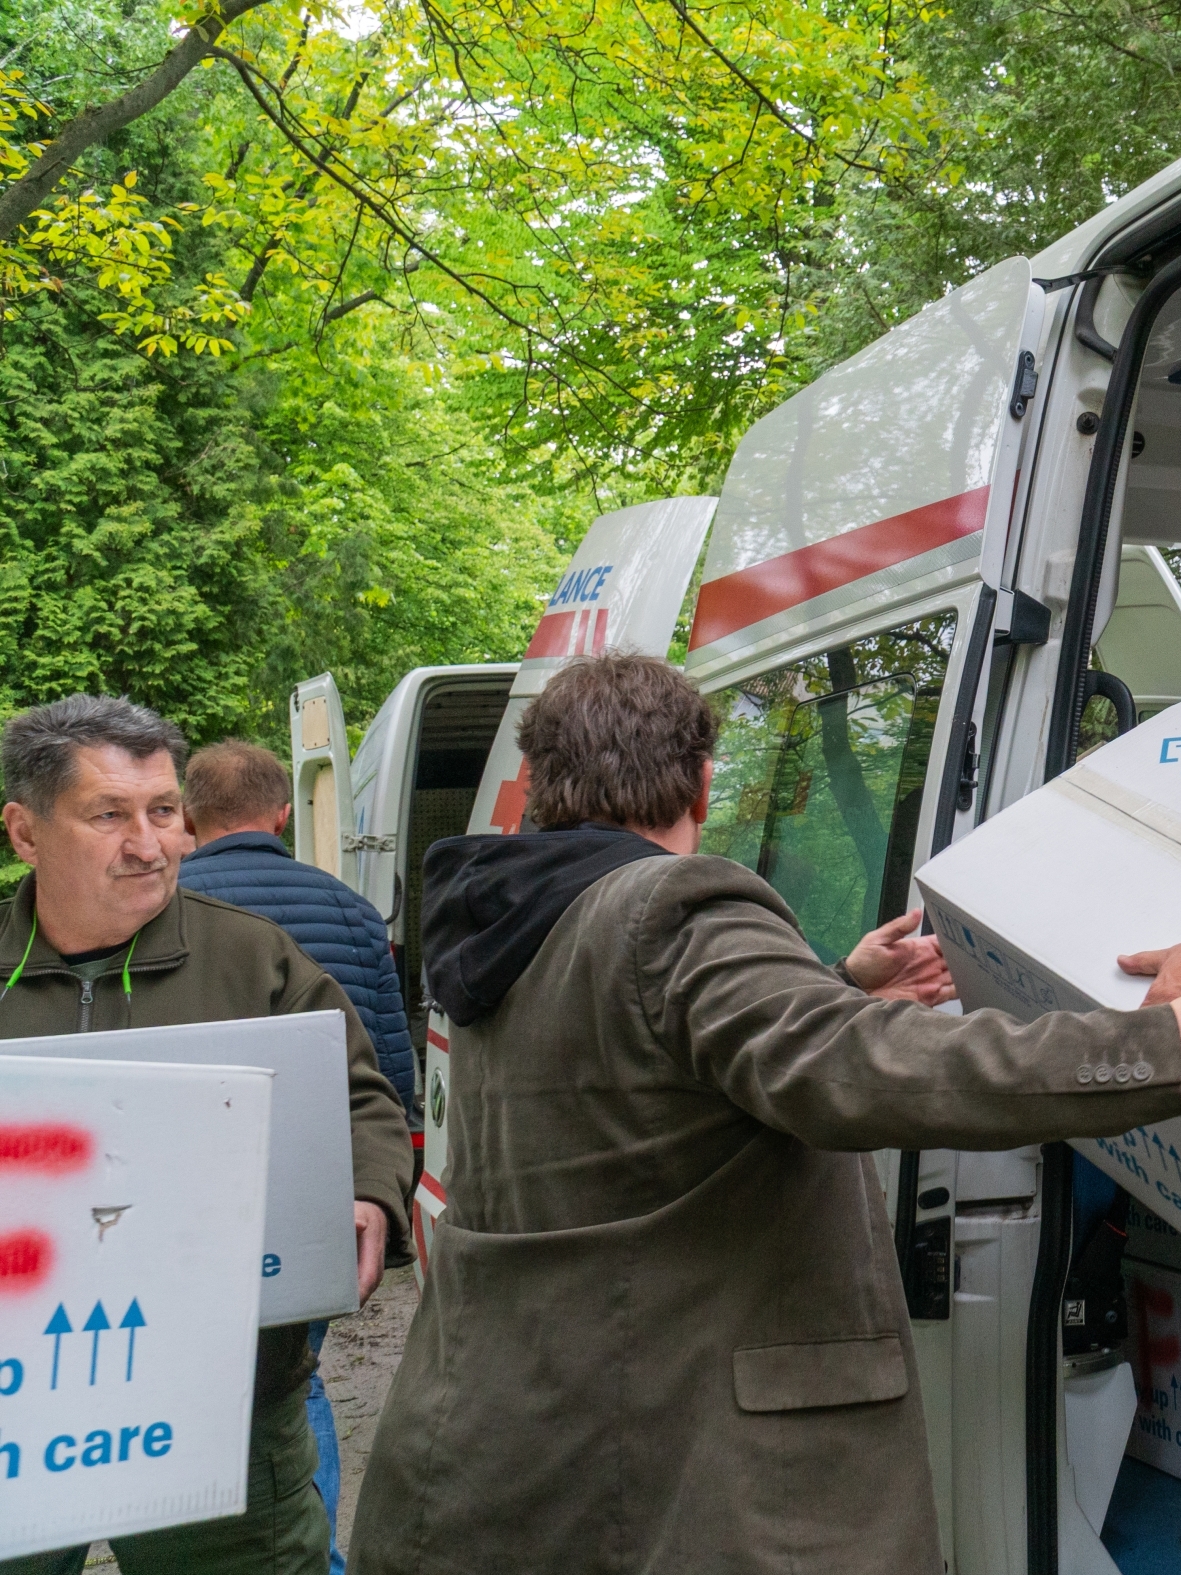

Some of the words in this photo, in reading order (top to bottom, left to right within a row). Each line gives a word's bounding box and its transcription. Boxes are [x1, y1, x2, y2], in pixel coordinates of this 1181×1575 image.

[1096, 1137, 1150, 1185] with
[44, 1420, 174, 1473] care
[1139, 1414, 1172, 1443] with
